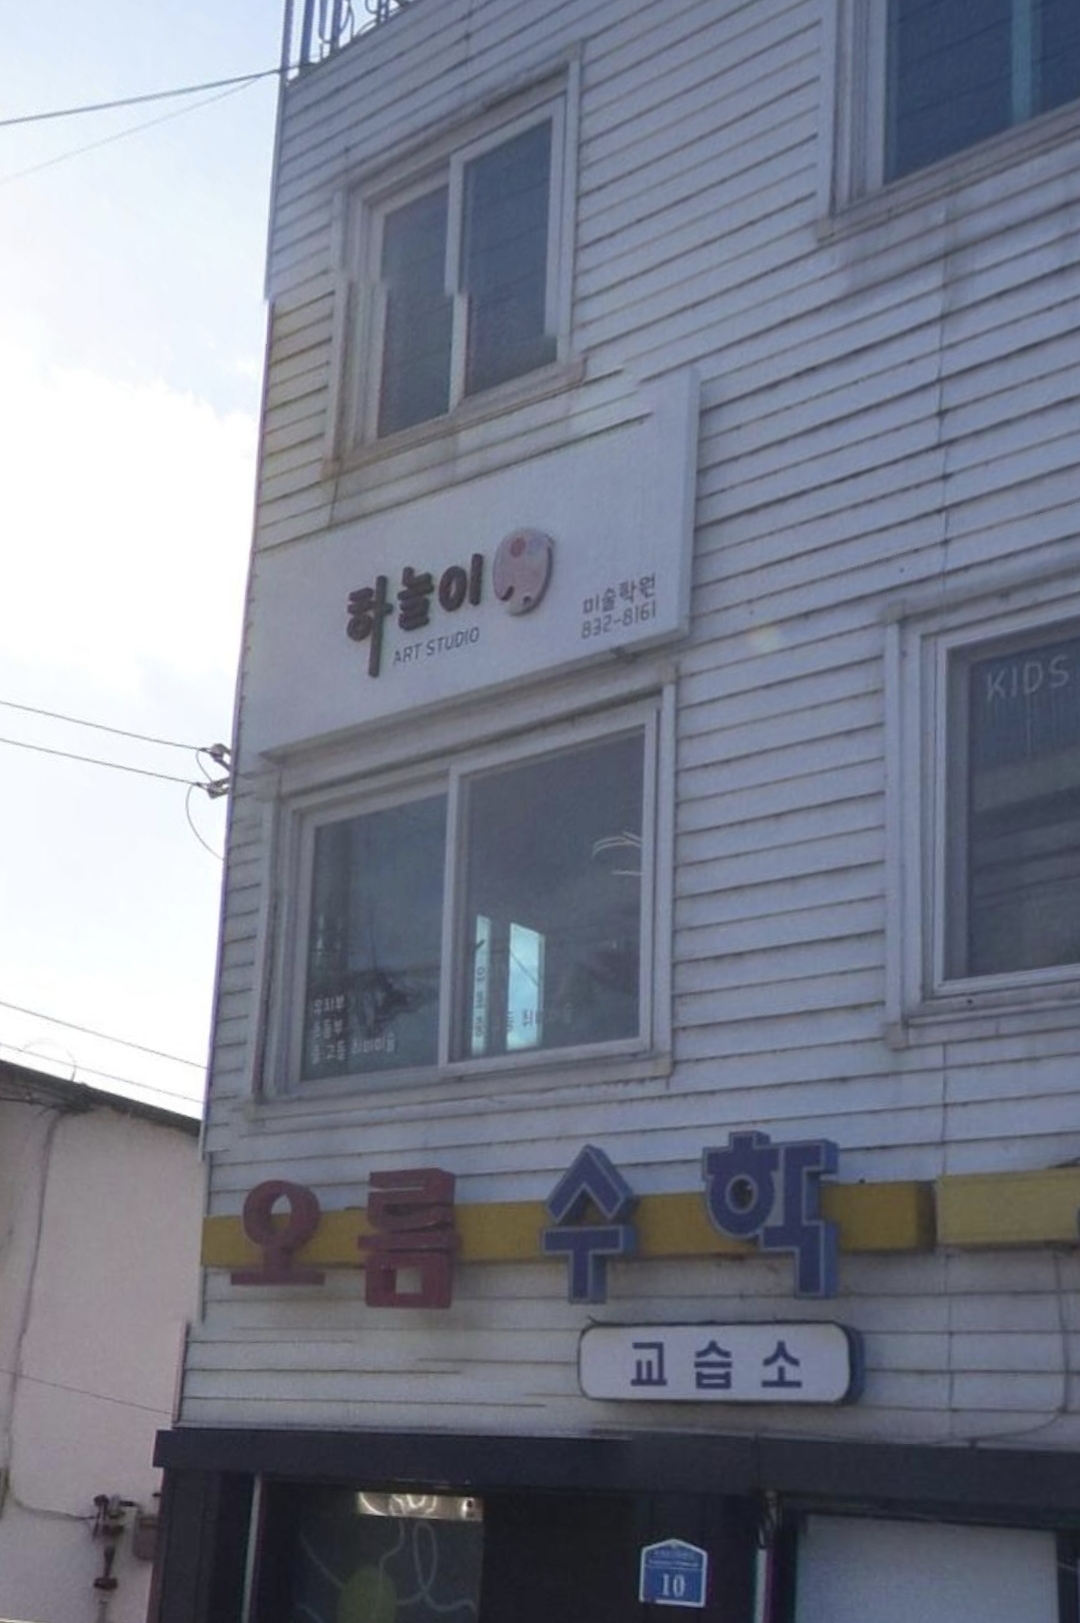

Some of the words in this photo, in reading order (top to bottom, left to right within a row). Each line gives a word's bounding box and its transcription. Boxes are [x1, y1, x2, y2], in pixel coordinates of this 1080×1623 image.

[583, 573, 656, 615] 미술학원
[581, 600, 656, 640] 832-8161
[393, 643, 423, 666] ART
[426, 626, 480, 656] STUDIO
[986, 654, 1069, 702] KIDS
[541, 1130, 839, 1304] 수학
[630, 1340, 803, 1390] 교습소
[662, 1573, 686, 1598] 10
